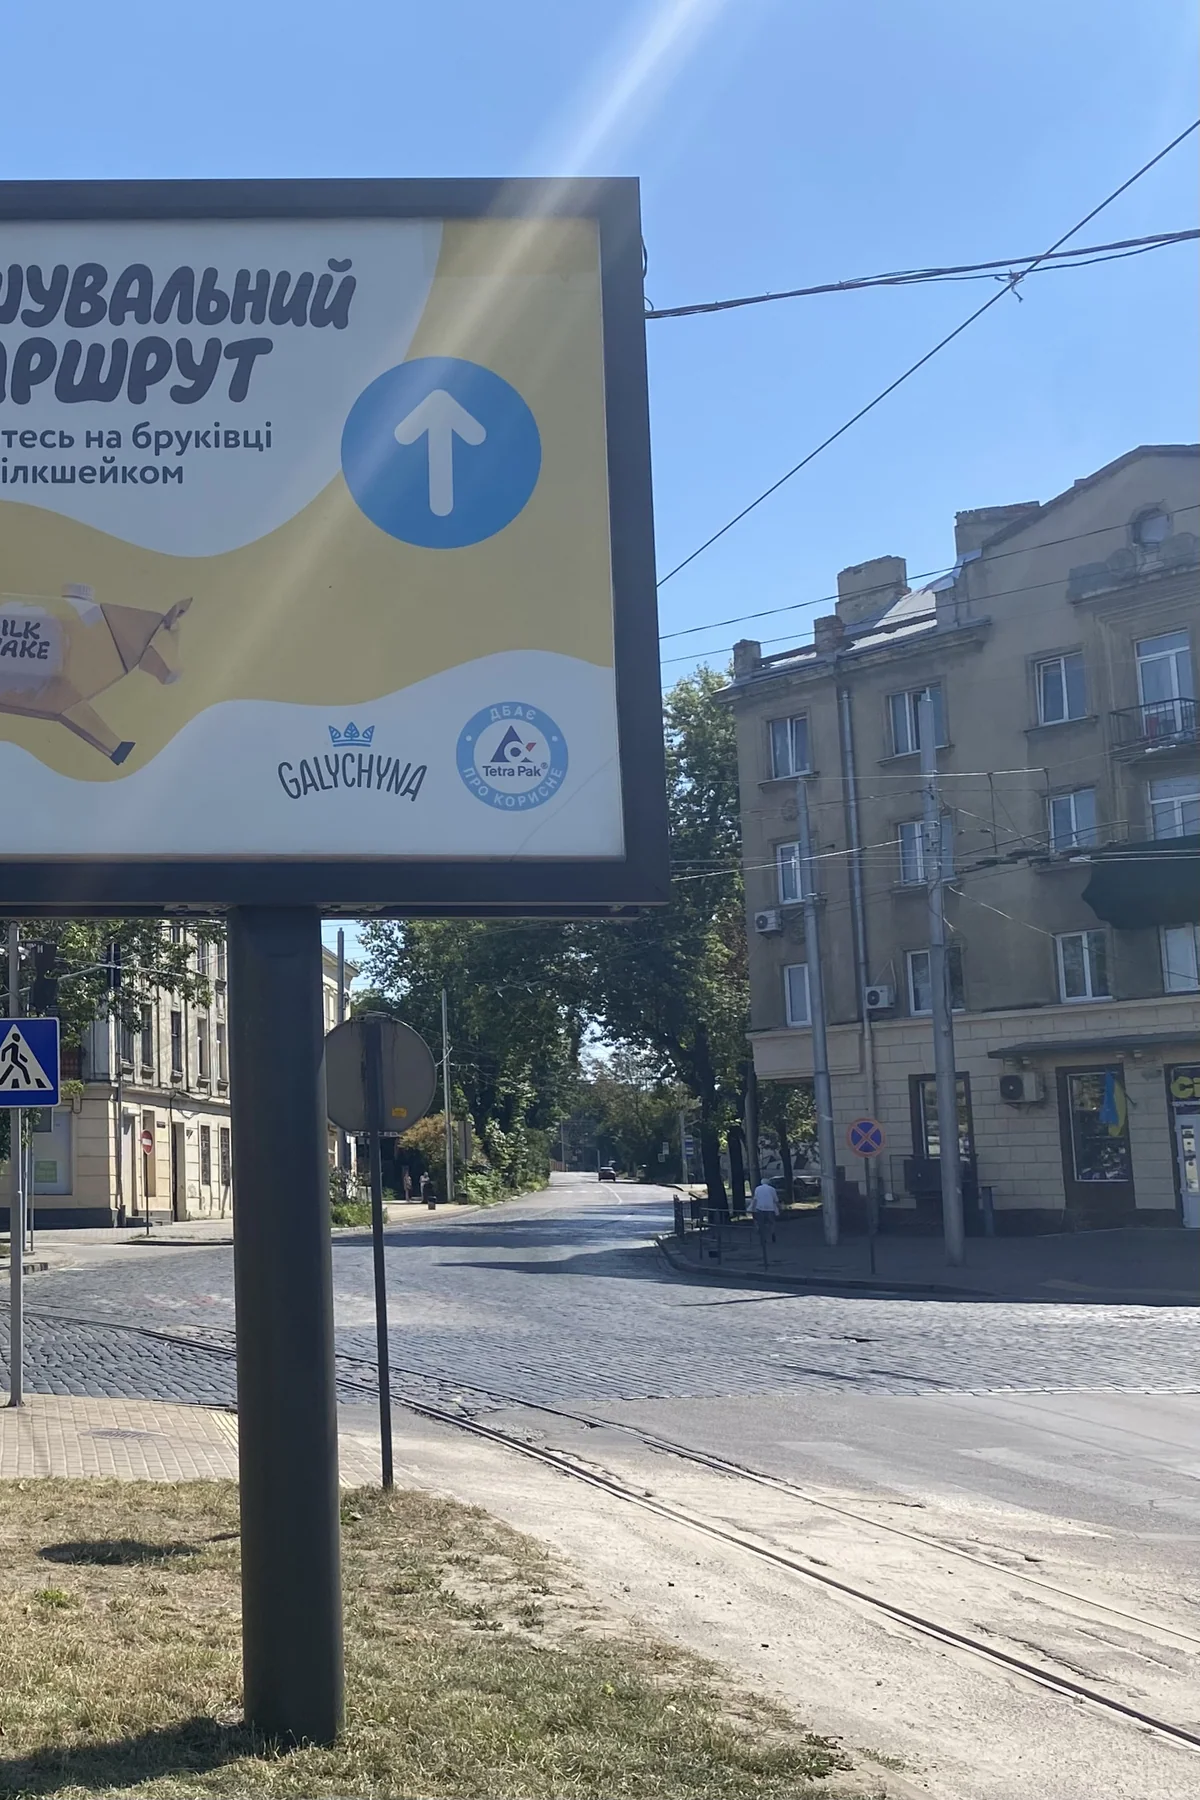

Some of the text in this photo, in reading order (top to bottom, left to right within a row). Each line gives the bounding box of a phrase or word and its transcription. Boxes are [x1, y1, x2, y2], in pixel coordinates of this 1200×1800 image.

[86, 430, 121, 449] на
[132, 421, 272, 455] бруківці
[490, 705, 536, 721] ДБАЄ
[277, 753, 428, 802] GALYCHYNA
[463, 767, 562, 807] ПРО КОРИСНЕ
[482, 765, 515, 777] Tetra
